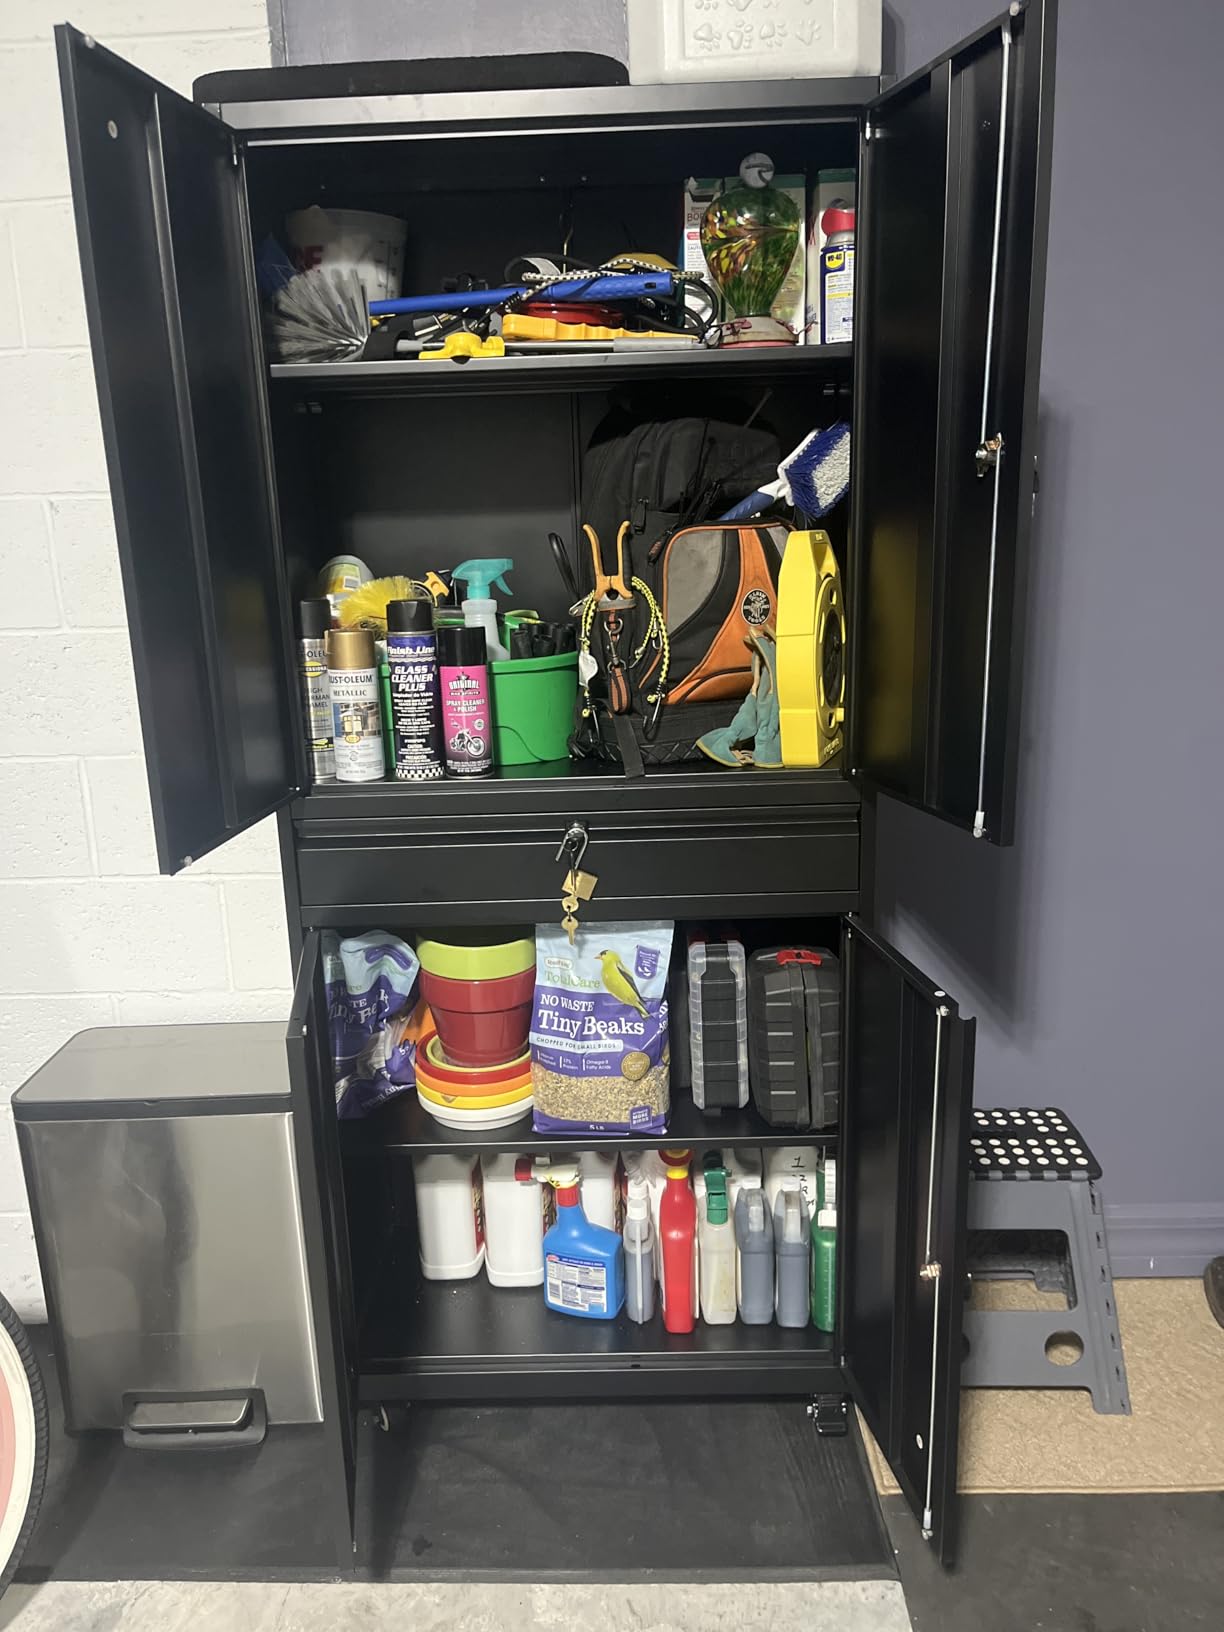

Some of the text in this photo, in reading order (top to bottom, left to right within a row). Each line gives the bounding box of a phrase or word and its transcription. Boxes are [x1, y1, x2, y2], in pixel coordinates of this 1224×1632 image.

[395, 666, 428, 674] GLASS
[391, 673, 434, 683] CLEANER
[398, 682, 426, 692] PLUS
[540, 993, 595, 1012] NO WASTE
[538, 1009, 582, 1039] Tiny
[582, 1015, 645, 1036] Beaks
[536, 1037, 563, 1047] CHOPPED
